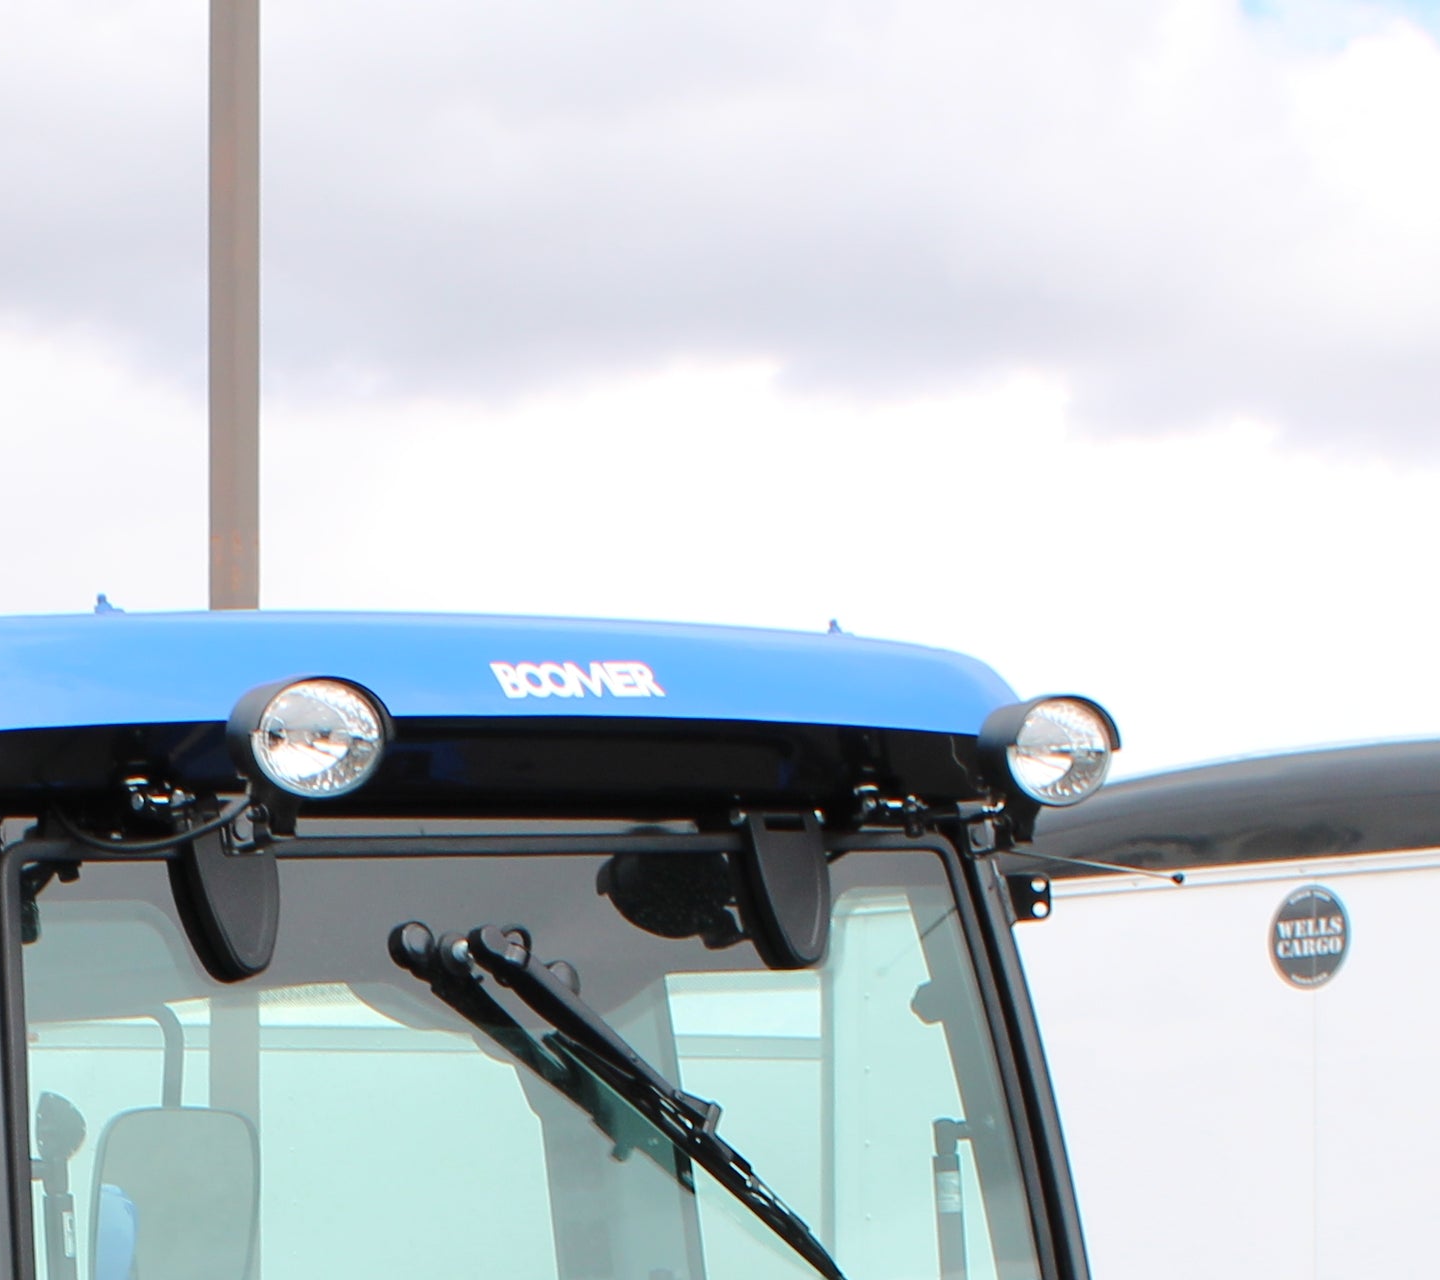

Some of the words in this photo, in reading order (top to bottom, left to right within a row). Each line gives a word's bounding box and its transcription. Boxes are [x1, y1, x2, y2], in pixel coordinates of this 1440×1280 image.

[489, 661, 667, 699] BOOMER
[1277, 916, 1343, 939] WELLS
[1277, 936, 1343, 959] CARGO
